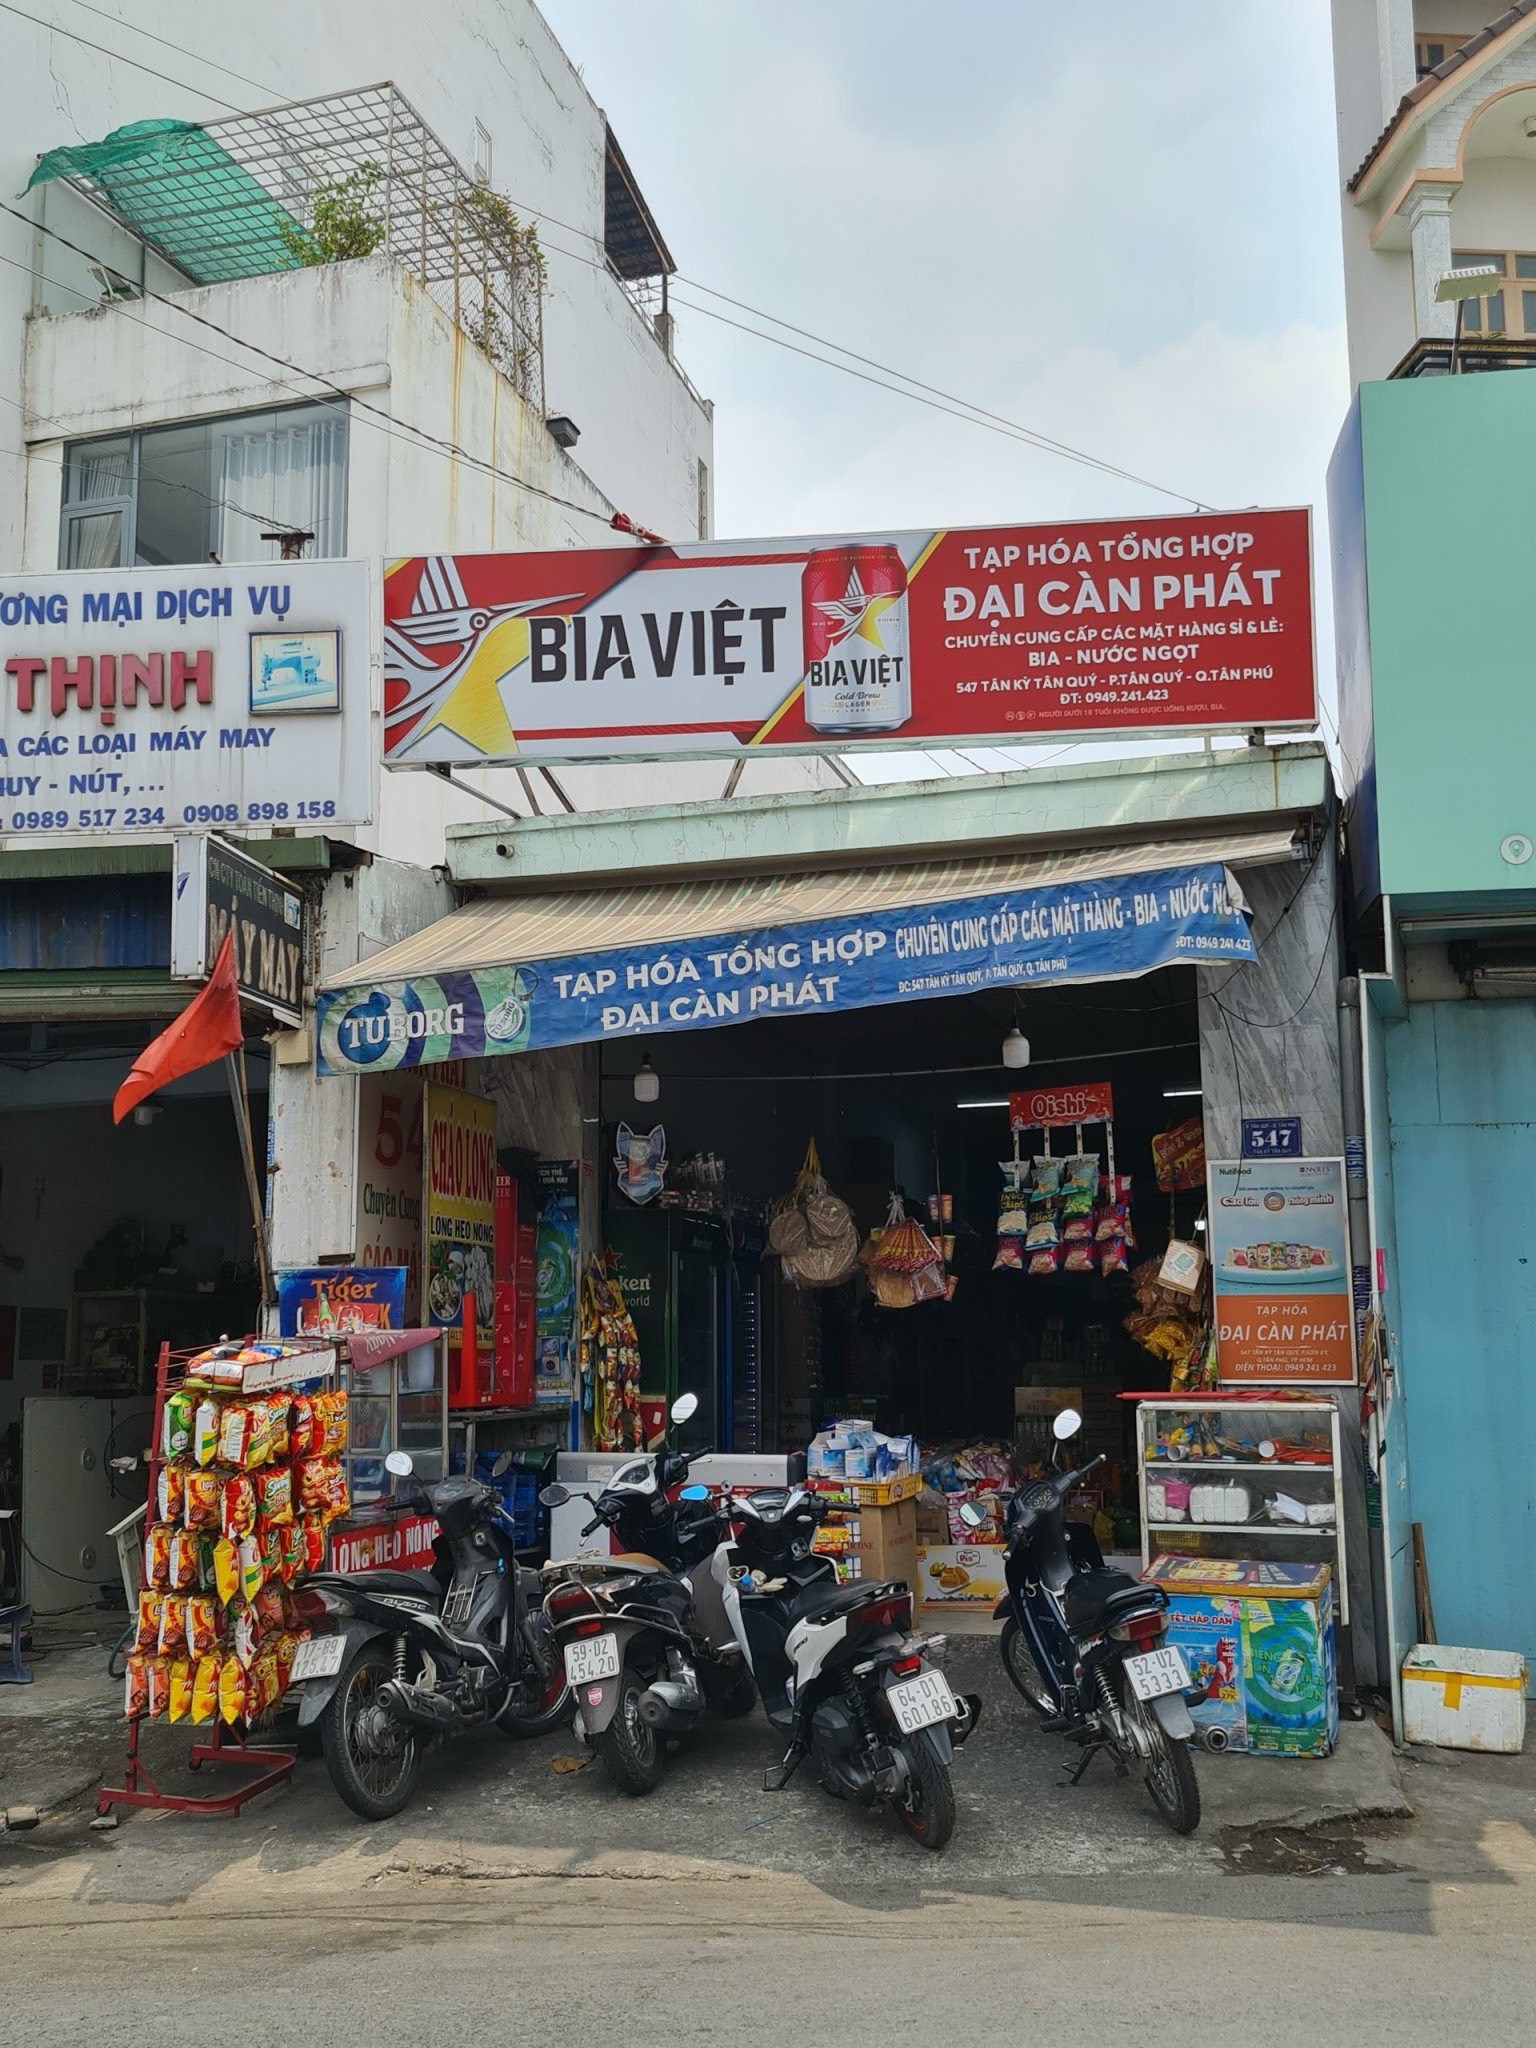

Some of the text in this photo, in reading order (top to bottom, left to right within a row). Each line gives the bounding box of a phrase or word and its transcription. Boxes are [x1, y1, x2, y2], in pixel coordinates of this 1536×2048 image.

[964, 531, 1254, 573] TẠP HÓA TỔNG HỢP
[0, 585, 292, 628] ƠNG MẠI DỊCH VỤ
[943, 562, 1281, 628] ĐẠI CÀN PHÁT
[529, 599, 787, 686] BIA VIỆT
[944, 627, 1012, 649] CHUYÊN
[1014, 630, 1062, 645] CUNG
[1064, 623, 1098, 643] CẤP
[1101, 620, 1137, 641] CÁC
[1139, 621, 1175, 641] MẶT
[1178, 618, 1226, 637] HÀNG
[1246, 621, 1257, 634] &
[810, 653, 904, 688] BIA VIỆT
[1028, 650, 1061, 667] BIA
[1077, 646, 1138, 665] NƯỚC
[1142, 643, 1199, 664] NGỌT
[5, 650, 213, 726] THỊNH
[956, 682, 978, 694] 547
[981, 678, 1011, 692] TÂN
[1013, 674, 1031, 691] KỲ
[1033, 675, 1064, 690] TÂN
[1066, 671, 1097, 689] QUÝ
[1152, 669, 1184, 686] QUÝ
[1243, 664, 1273, 680] PHÚ
[834, 691, 881, 701] Cold Brew
[1059, 688, 1169, 705] ĐT: 0949.241.423
[17, 731, 69, 757] CÁC
[78, 733, 136, 760] LOẠI
[150, 725, 207, 752] MÁY
[219, 727, 276, 749] MAY
[69, 768, 131, 796] NÚT,
[12, 810, 69, 830] 0989
[78, 808, 115, 828] 517
[124, 807, 165, 826] 234
[183, 803, 239, 823] 0908
[247, 801, 289, 821] 898
[296, 800, 336, 819] 158
[895, 915, 949, 960] CHUYÊN
[951, 915, 989, 949] CUNG
[990, 902, 1018, 947] CẤP
[1020, 898, 1050, 941] CÁC
[1051, 896, 1081, 944] MẶT
[1082, 891, 1125, 931] HÀNG
[1133, 893, 1160, 926] BIA
[1169, 878, 1210, 920] NƯỚC
[1211, 885, 1242, 925] NG
[1195, 936, 1218, 949] 0949
[1219, 937, 1235, 949] 241
[1235, 938, 1252, 951] 423
[553, 929, 887, 1003] TẠP HÓA TỔNG HỢP
[911, 979, 925, 991] 547
[925, 974, 940, 989] TÂN
[940, 972, 950, 988] KỲ
[950, 971, 966, 986] TÂN
[992, 964, 1008, 978] TÂN
[1036, 957, 1051, 972] TÂN
[1051, 955, 1068, 971] PHÚ
[601, 968, 840, 1033] ĐẠI CÀN PHÁT
[344, 1003, 465, 1050] TUBORG
[1031, 1092, 1087, 1119] Oishi
[430, 1103, 495, 1204] CHÁO LÒNG
[1251, 1129, 1292, 1148] 547
[496, 1175, 511, 1187] EER
[363, 1182, 397, 1224] Chuyên
[430, 1211, 494, 1244] LÒNG HEO NÓNG
[311, 1270, 378, 1302] Tiger
[619, 1274, 651, 1291] ken
[1256, 1304, 1308, 1317] TẠP HÓA
[1220, 1325, 1250, 1345] ĐẠI
[1257, 1321, 1294, 1341] CÀN
[1301, 1321, 1348, 1341] PHÁT
[1284, 1363, 1305, 1371] 0949
[1305, 1363, 1320, 1371] 241
[1321, 1363, 1337, 1371] 423
[332, 1520, 440, 1574] LÒNG HEO NÓNG
[382, 1597, 428, 1611] BLADE
[293, 1654, 339, 1677] 125.47
[570, 1655, 616, 1683] 454.20
[1132, 1650, 1176, 1677] 52-U2
[896, 1675, 937, 1708] 64-D1
[1139, 1669, 1184, 1696] 5333
[902, 1694, 952, 1731] 601.86
